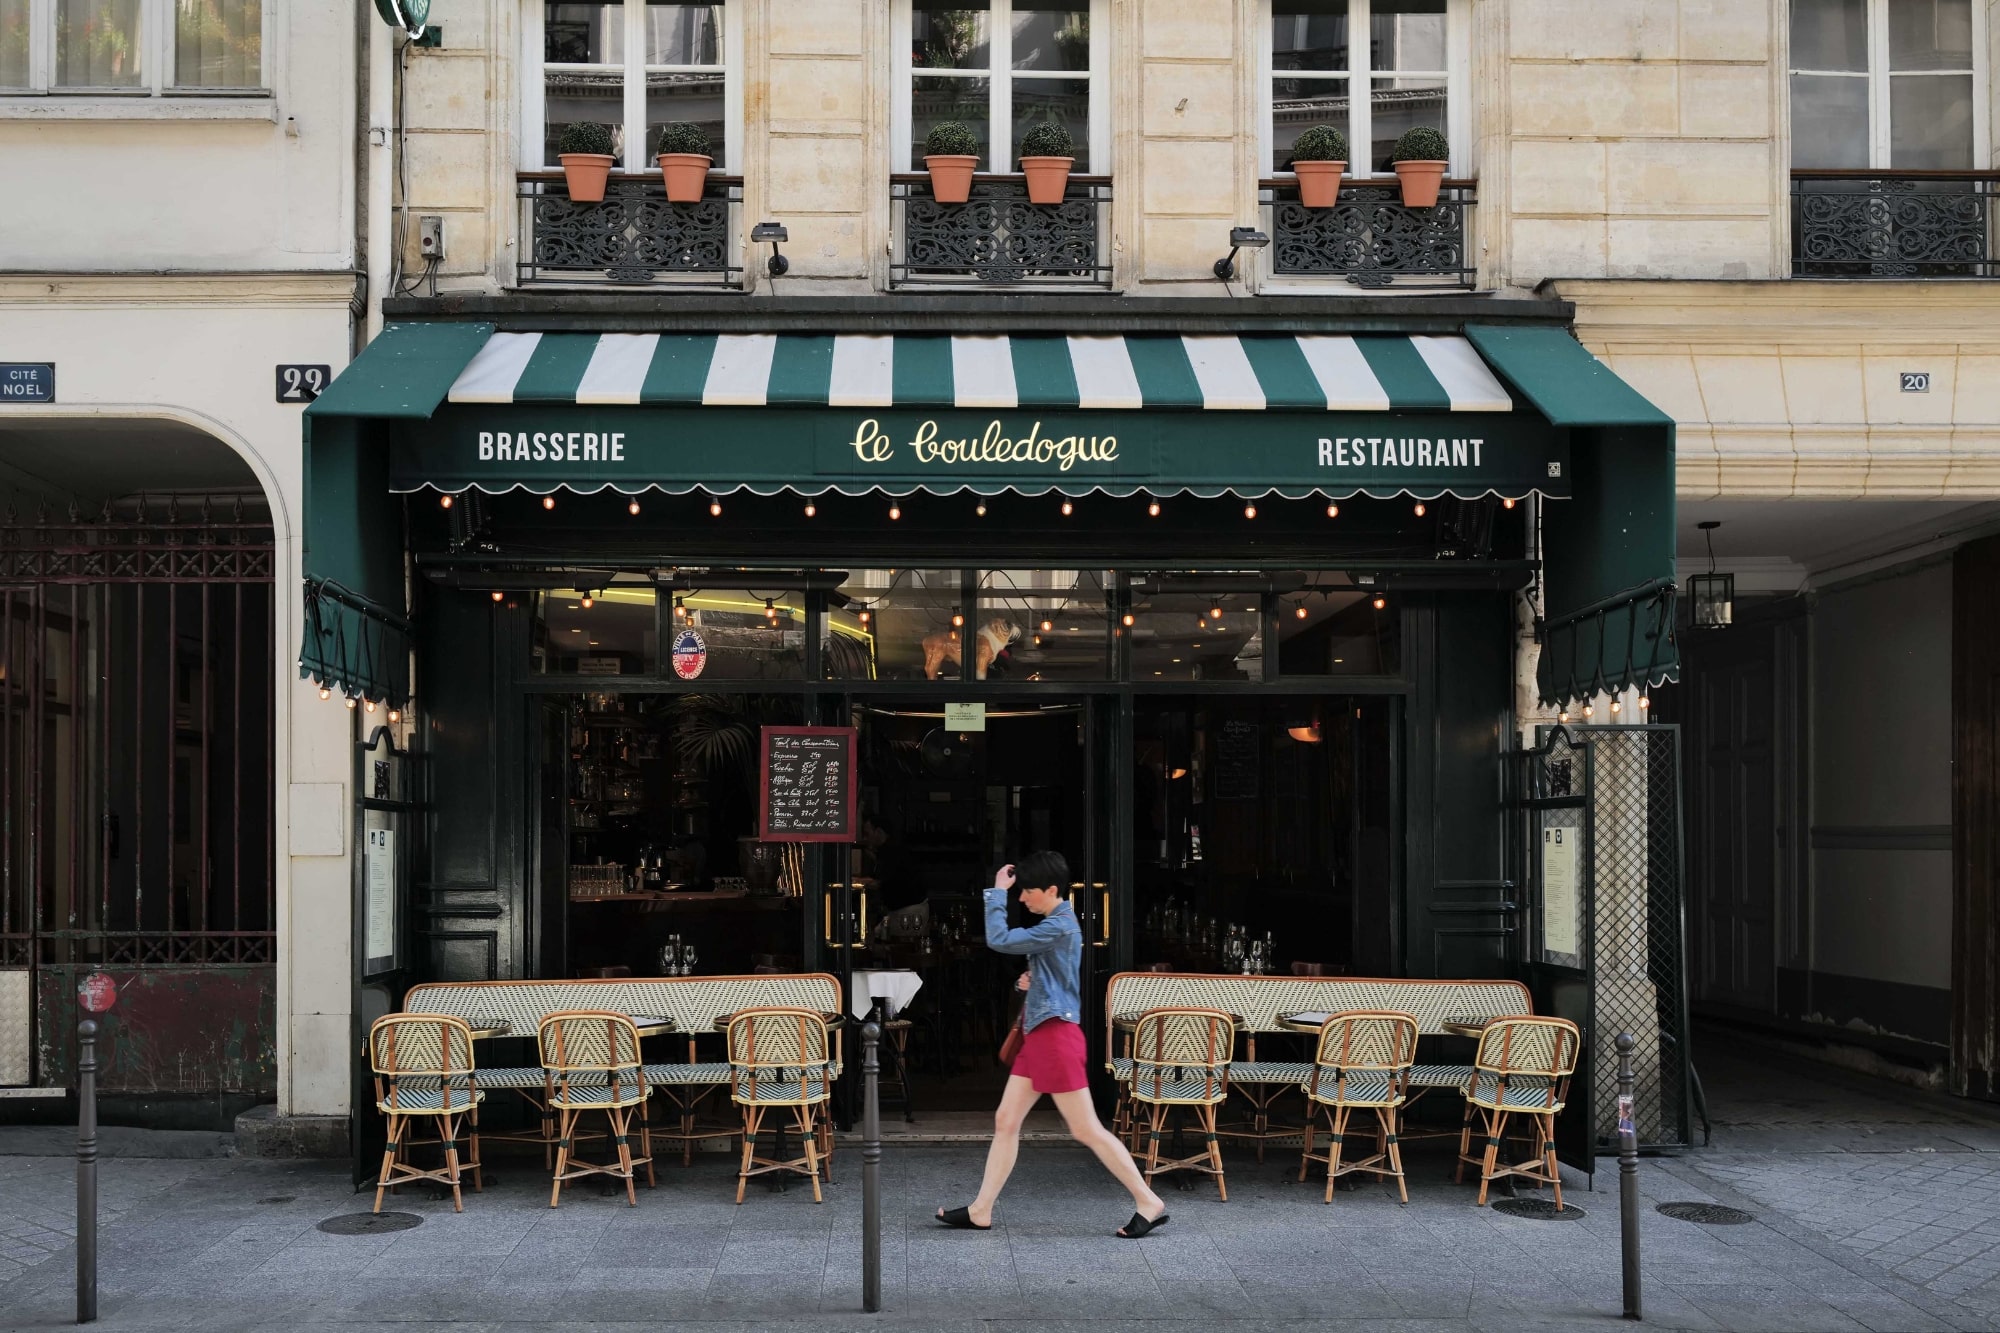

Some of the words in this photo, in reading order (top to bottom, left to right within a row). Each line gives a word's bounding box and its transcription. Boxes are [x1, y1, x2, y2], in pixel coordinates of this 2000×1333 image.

[10, 370, 38, 380] CITÉ
[283, 368, 322, 398] 22
[1904, 376, 1926, 390] 20
[4, 384, 44, 395] NOEL
[478, 432, 625, 462] BRASSERIE
[849, 418, 894, 462] le
[908, 420, 1120, 471] bouledogue
[1318, 438, 1484, 467] RESTAURANT
[692, 632, 705, 650] PARIS
